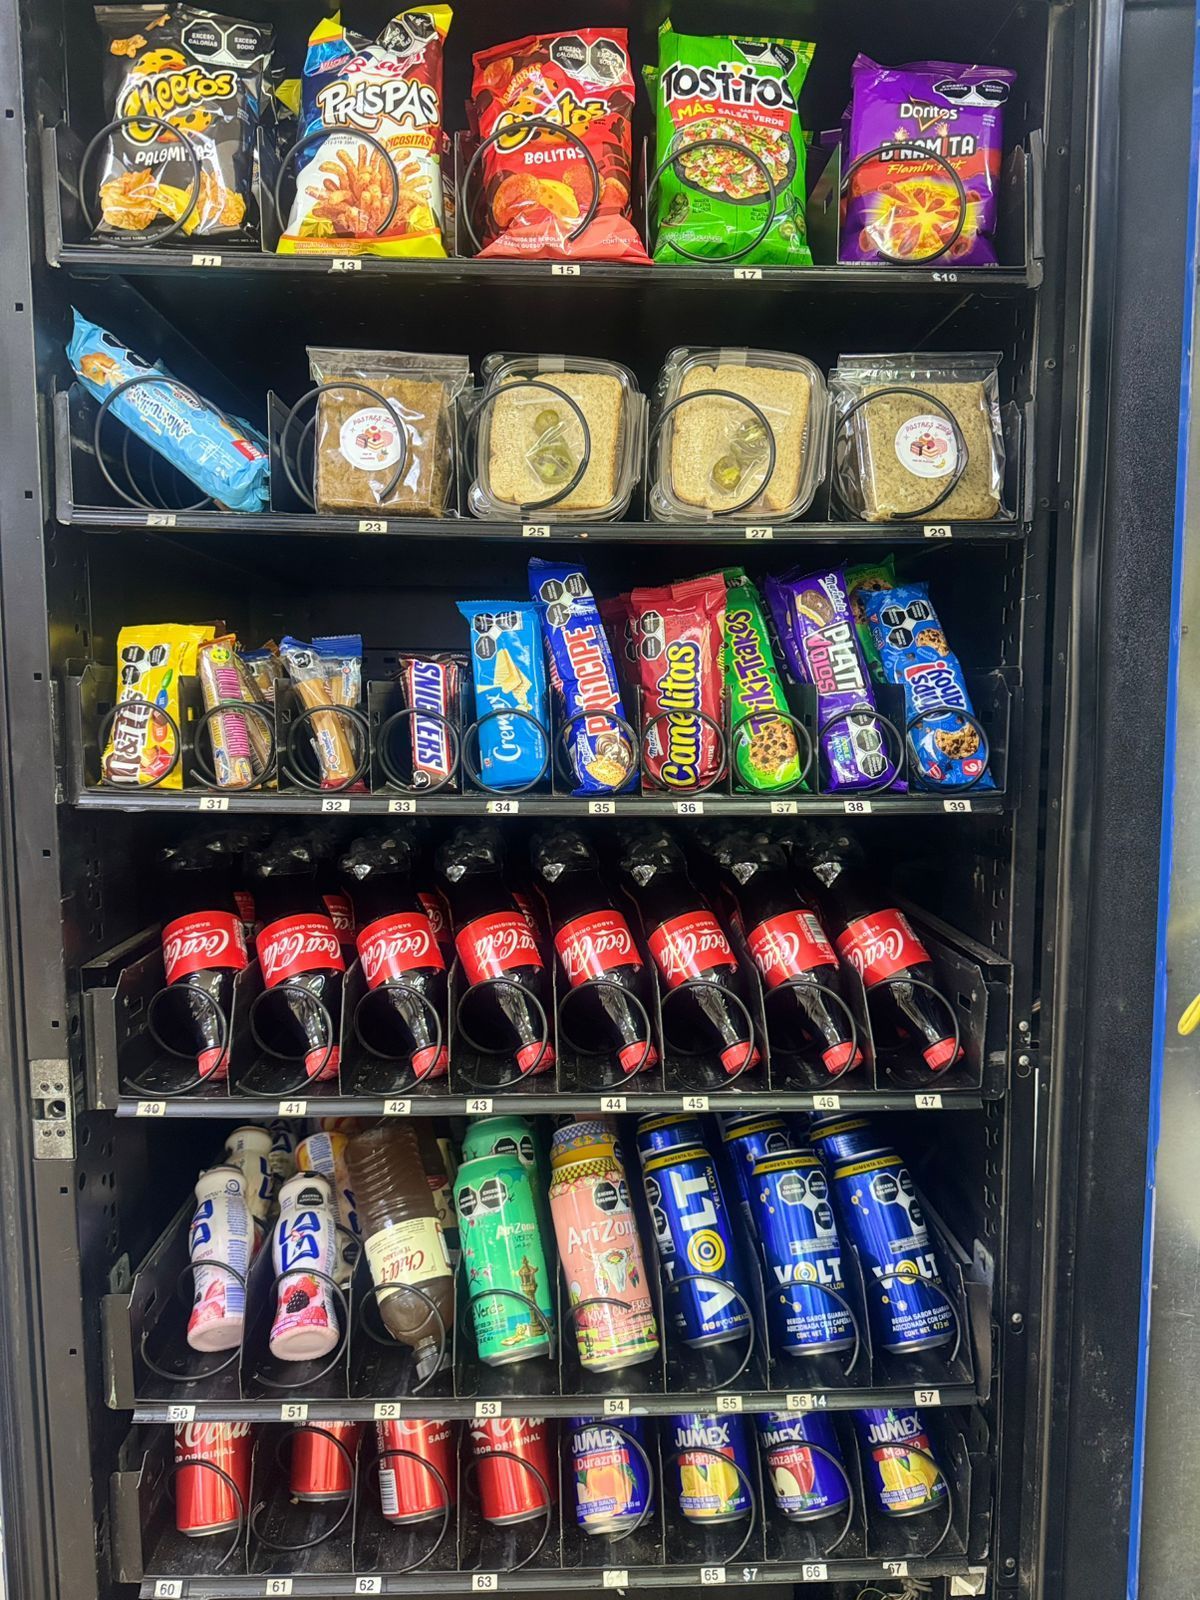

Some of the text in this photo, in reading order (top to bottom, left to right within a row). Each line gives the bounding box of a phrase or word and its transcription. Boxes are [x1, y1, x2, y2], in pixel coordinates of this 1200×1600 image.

[121, 69, 234, 143] Cheetos
[677, 101, 716, 121] MÁS
[901, 104, 958, 119] Doritos
[717, 108, 785, 127] SALSA VERDE
[524, 147, 586, 165] BOLITAS
[339, 261, 356, 270] 13
[558, 266, 575, 275] 15
[740, 271, 757, 279] 17
[365, 522, 381, 532] 23
[528, 527, 545, 537] 25
[929, 528, 946, 536] 29
[750, 529, 767, 539] 27
[658, 645, 698, 786] Canelitas
[206, 799, 222, 808] 31
[326, 802, 342, 811] 32
[394, 802, 410, 811] 33
[495, 803, 511, 812] 34
[595, 803, 610, 813] 35
[680, 803, 696, 813] 36
[776, 804, 791, 812] 37
[848, 803, 864, 812] 38
[949, 802, 966, 811] 39
[264, 931, 342, 978] Coca-Cola
[562, 928, 632, 982] Coca-Cola
[661, 928, 731, 982] Coca-Cola
[471, 1100, 488, 1111] 43
[605, 1099, 622, 1110] 44
[688, 1098, 704, 1109] 45
[819, 1098, 834, 1108] 46
[920, 1096, 936, 1106] 47
[144, 1103, 160, 1114] 40
[285, 1102, 301, 1113] 41
[389, 1102, 406, 1113] 42
[706, 1166, 721, 1210] YELLOW
[774, 1257, 842, 1289] VOLT
[871, 1253, 939, 1290] VOLT
[806, 1314, 826, 1324] SABOR
[913, 1310, 932, 1321] SABOR
[927, 1316, 940, 1325] CON
[933, 1322, 944, 1331] 473
[792, 1396, 806, 1407] 56
[920, 1392, 934, 1403] 57
[481, 1404, 496, 1414] 53
[610, 1401, 625, 1412] 54
[722, 1398, 737, 1409] 55
[171, 1408, 188, 1419] 50
[287, 1407, 302, 1417] 51
[380, 1405, 395, 1416] 52
[761, 1423, 804, 1447] UMEX
[868, 1415, 923, 1444] JUMEX
[572, 1427, 626, 1454] JUMEX
[675, 1423, 731, 1448] JUMEX
[494, 1432, 541, 1452] ORIGINAL
[184, 1448, 236, 1462] ORIGINAL
[767, 1452, 805, 1466] anzana
[577, 1452, 622, 1471] Durazno
[742, 1567, 758, 1582] $7
[806, 1567, 821, 1578] 66
[888, 1563, 903, 1575] 67
[704, 1570, 718, 1581] 65
[272, 1582, 287, 1593] 61
[359, 1580, 375, 1591] 62
[477, 1576, 492, 1588] 63
[160, 1584, 175, 1596] 60
